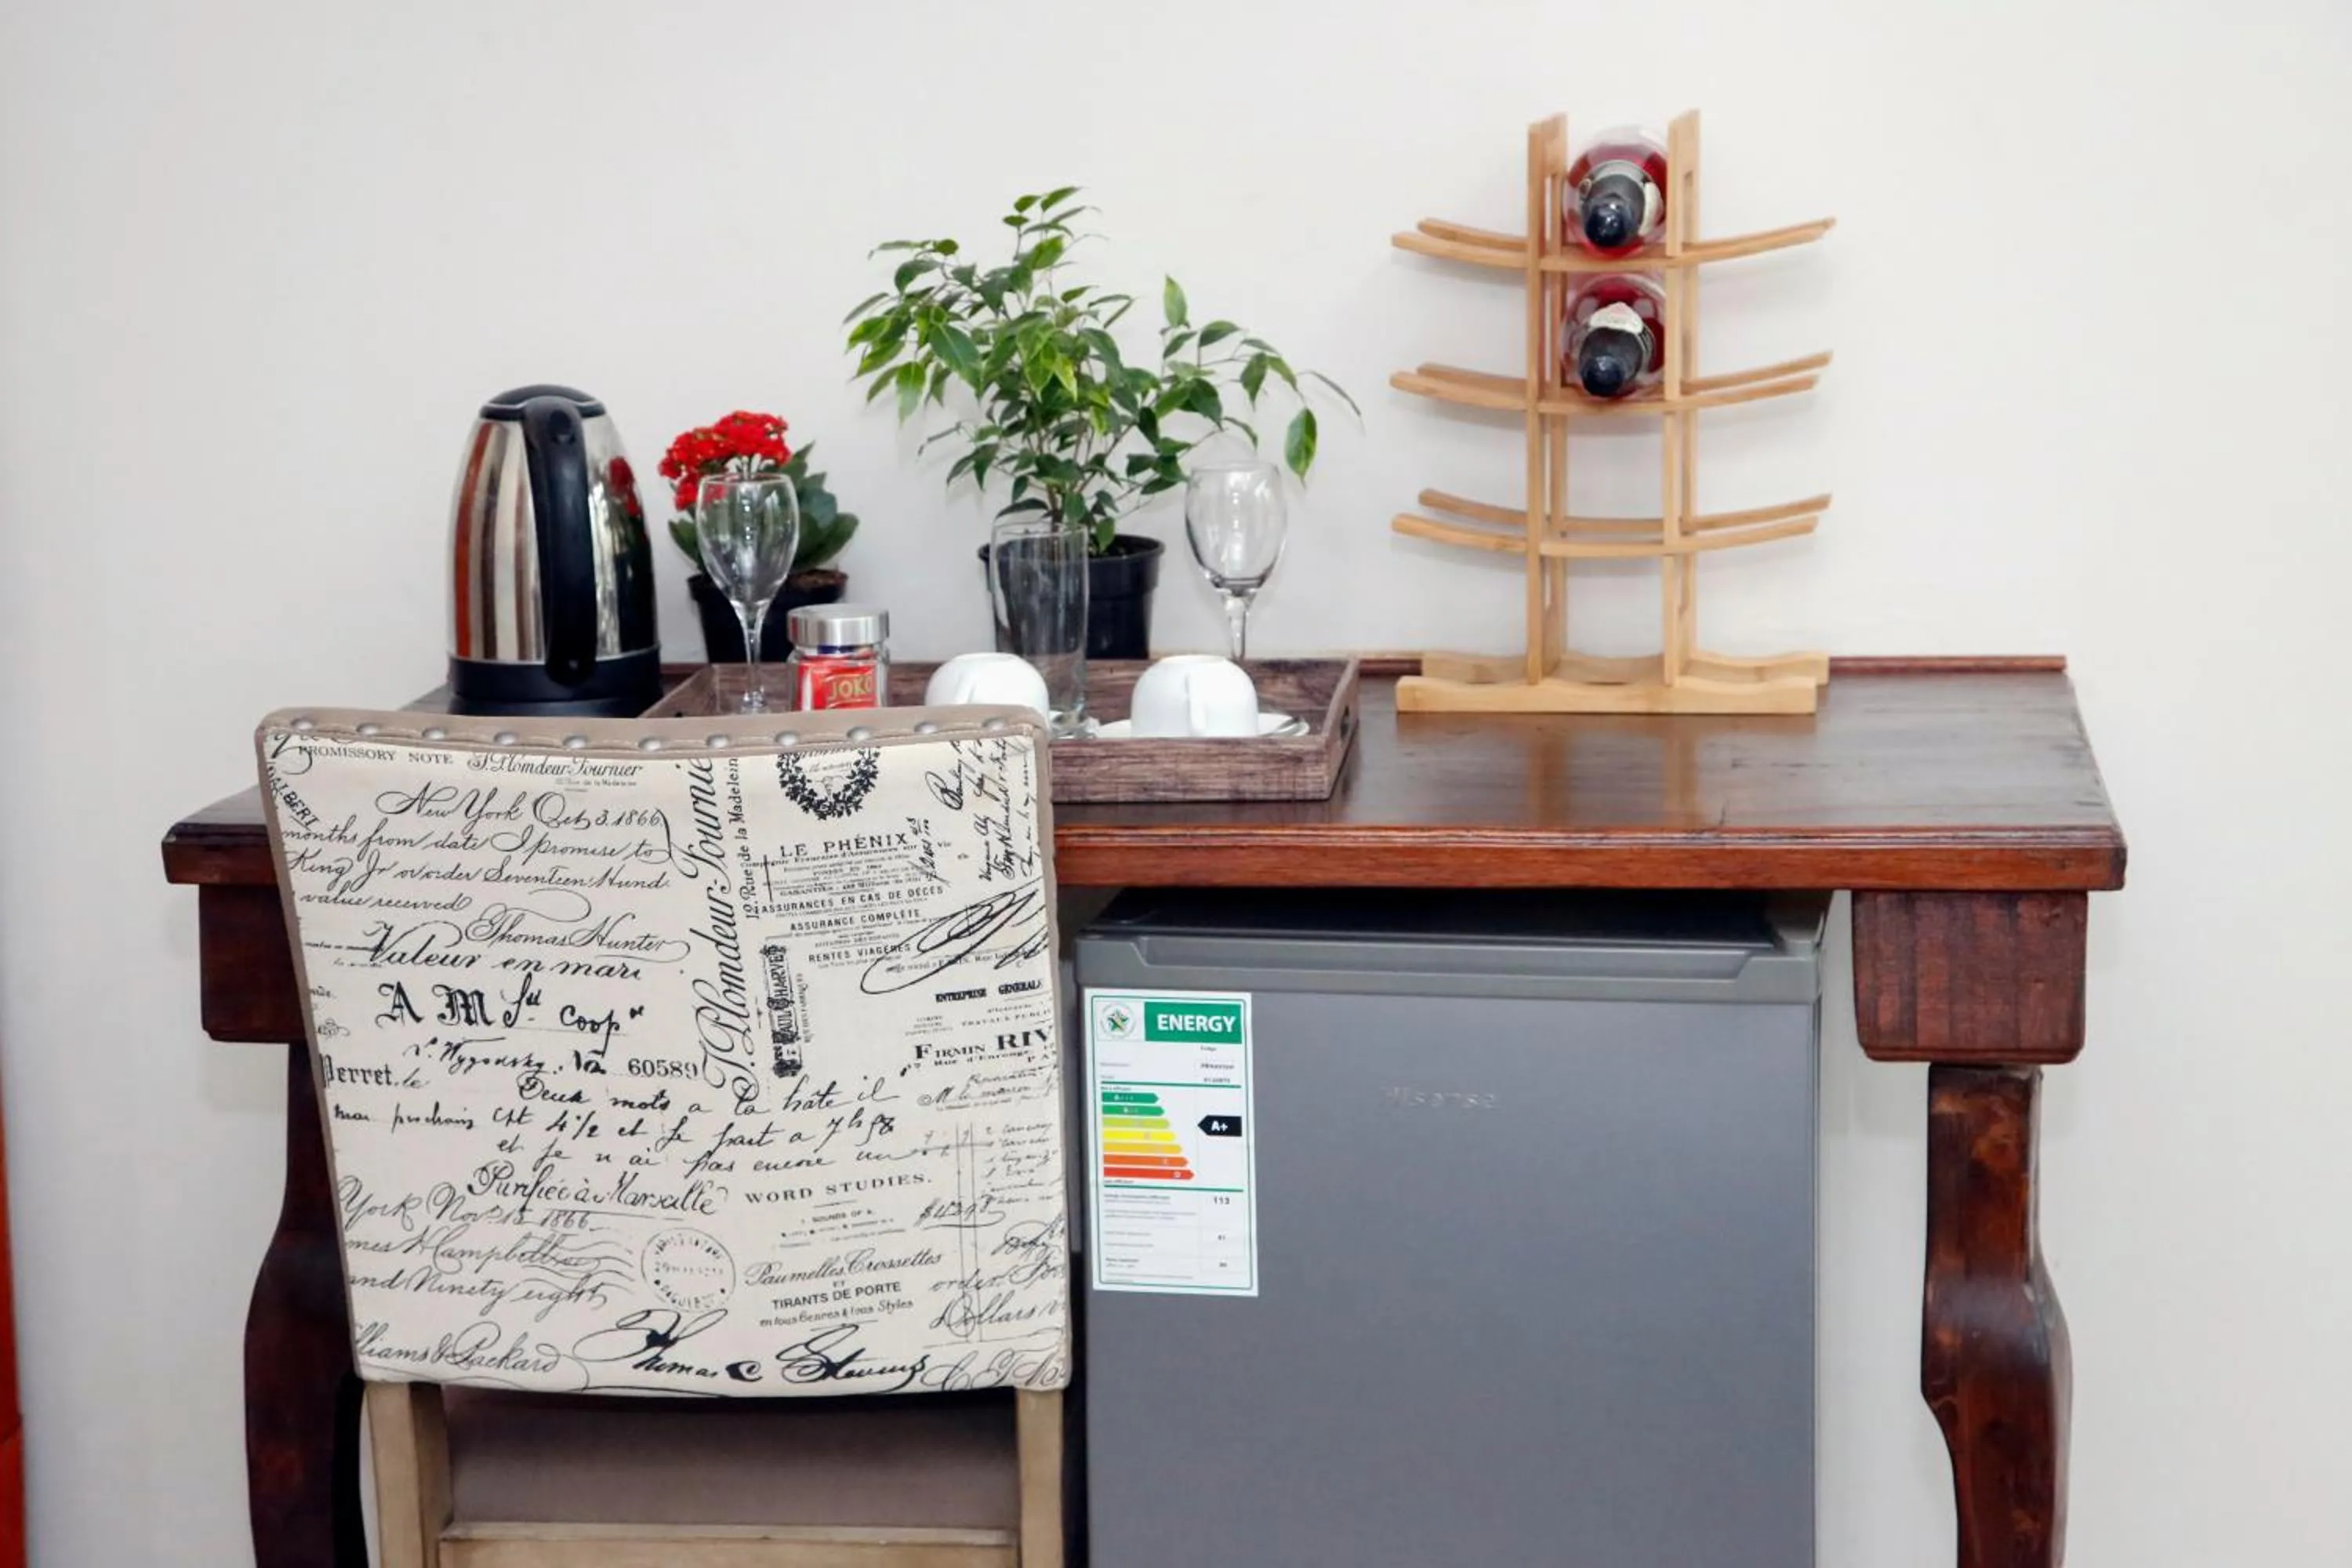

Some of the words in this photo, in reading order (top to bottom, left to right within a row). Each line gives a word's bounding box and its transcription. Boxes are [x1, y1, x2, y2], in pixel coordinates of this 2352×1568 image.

[408, 752, 453, 764] NOTE
[780, 844, 808, 857] LE
[1156, 1013, 1236, 1033] ENERGY
[628, 1058, 698, 1079] 60589
[1210, 1120, 1229, 1132] A+
[745, 1187, 813, 1204] WORD
[771, 1293, 829, 1309] TIRANTS
[833, 1289, 852, 1301] DE
[855, 1281, 902, 1298] PORTE
